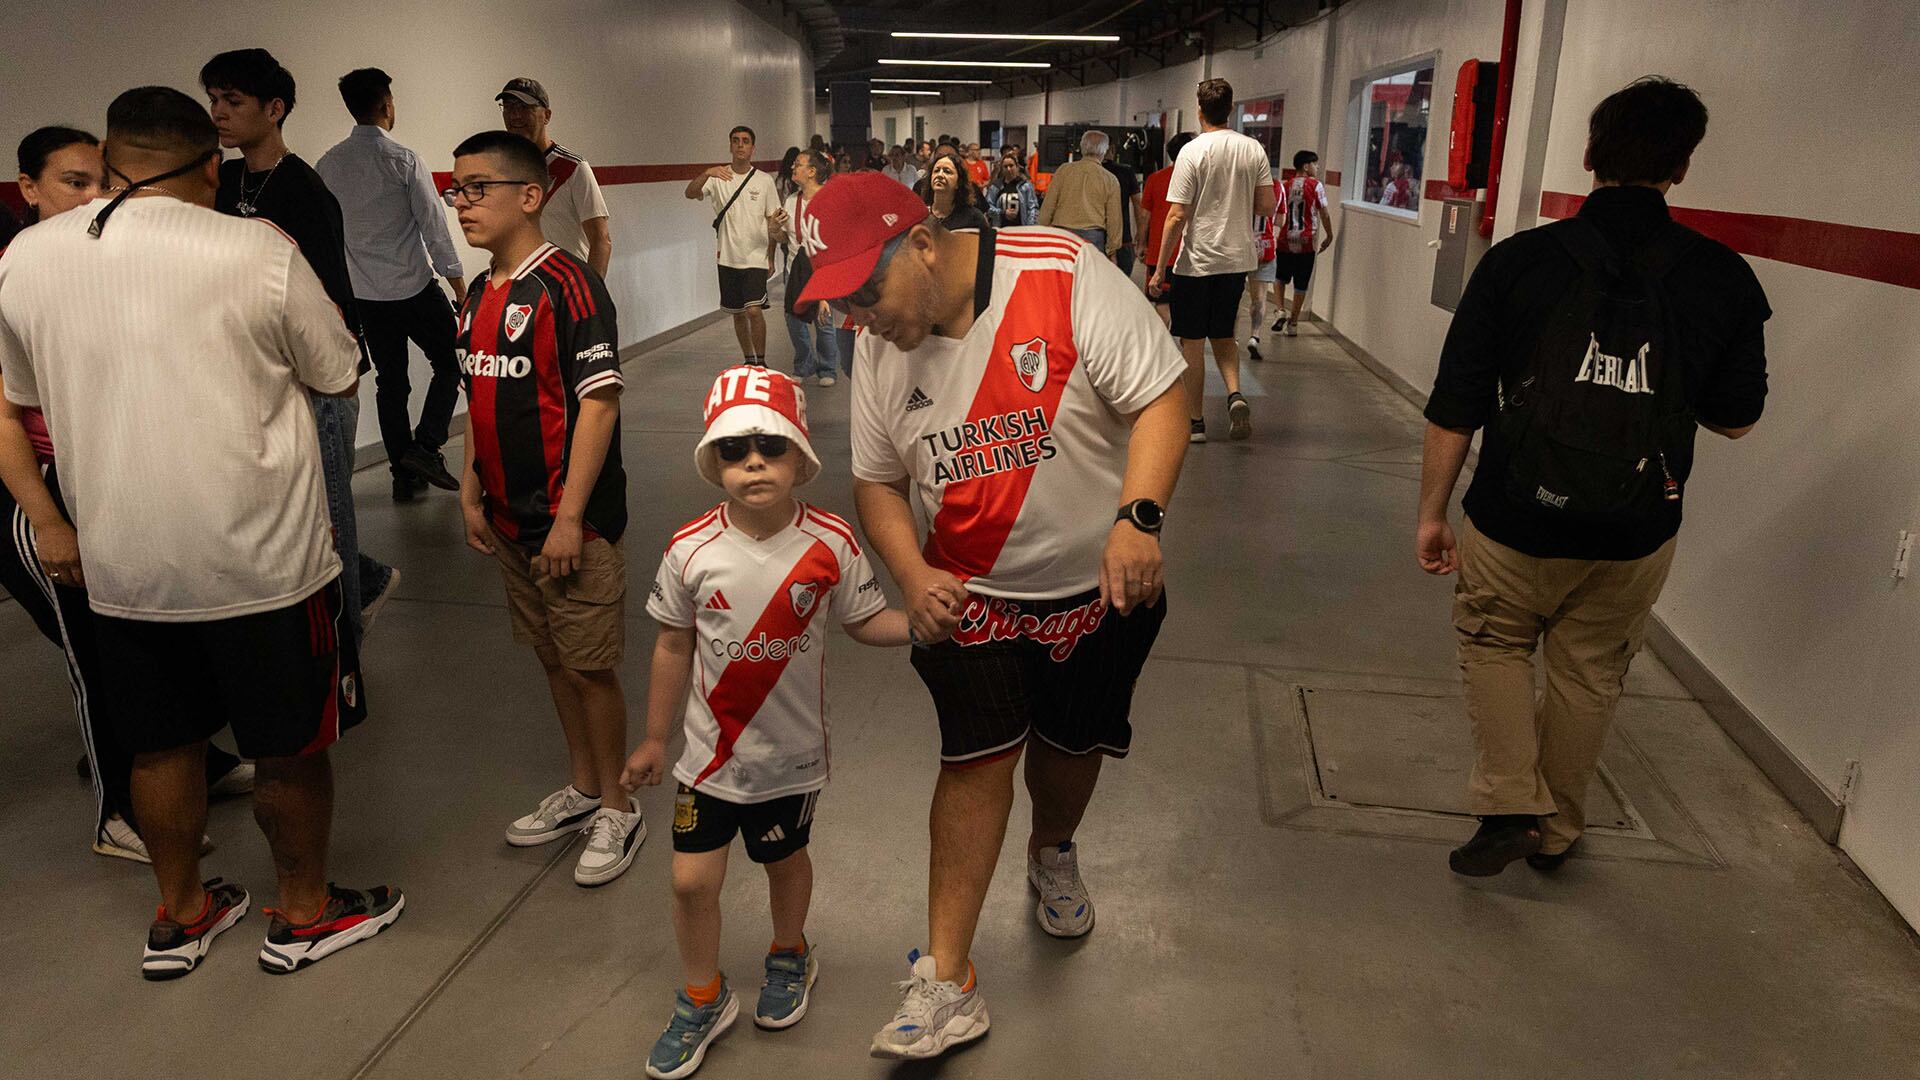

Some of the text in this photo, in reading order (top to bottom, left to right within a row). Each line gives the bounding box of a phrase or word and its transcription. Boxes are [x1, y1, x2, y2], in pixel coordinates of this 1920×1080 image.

[455, 348, 532, 379] Betano
[1575, 331, 1650, 393] EERLAT
[704, 367, 771, 421] ATE
[905, 398, 934, 412] adidas
[922, 406, 1049, 457] TURKISH
[934, 436, 1057, 485] AIRLINES
[711, 632, 810, 662] codere
[950, 592, 1108, 662] Chicago
